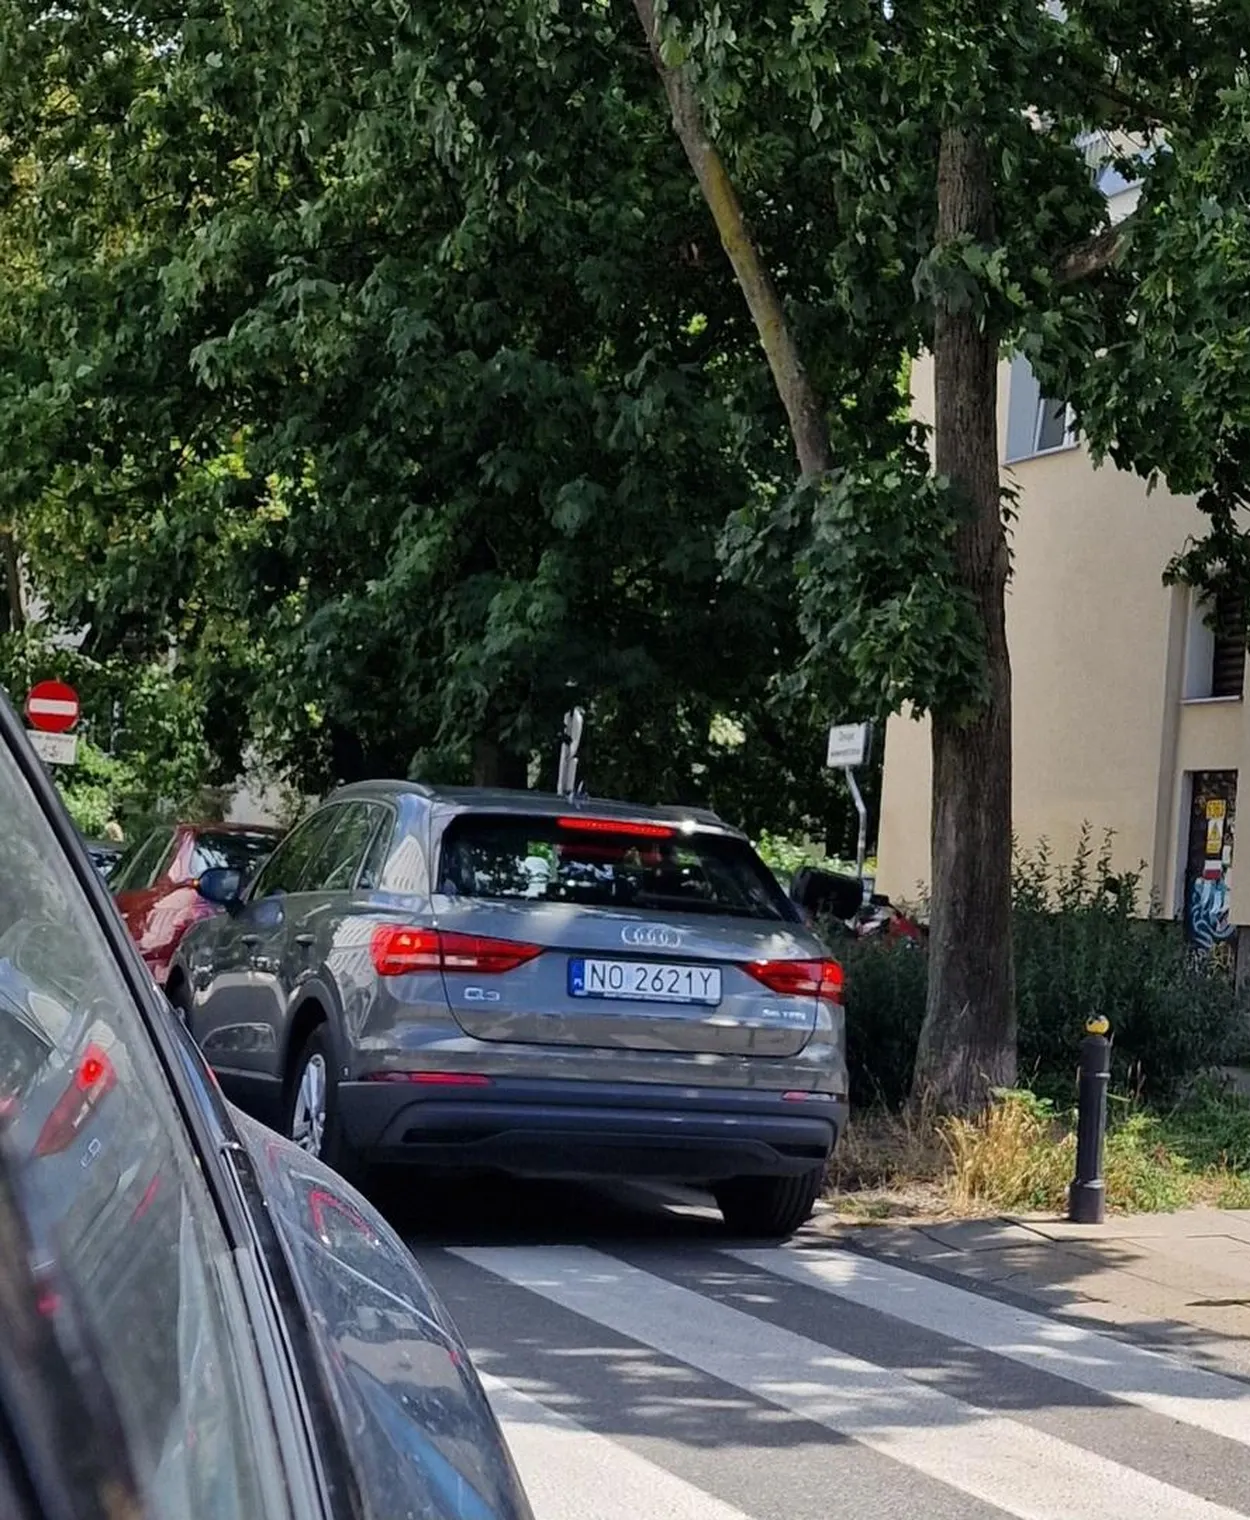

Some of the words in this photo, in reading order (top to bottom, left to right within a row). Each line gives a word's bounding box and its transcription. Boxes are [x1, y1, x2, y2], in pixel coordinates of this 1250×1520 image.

[590, 964, 623, 989] NO
[635, 967, 712, 995] 2621Y
[464, 987, 500, 1001] Q3
